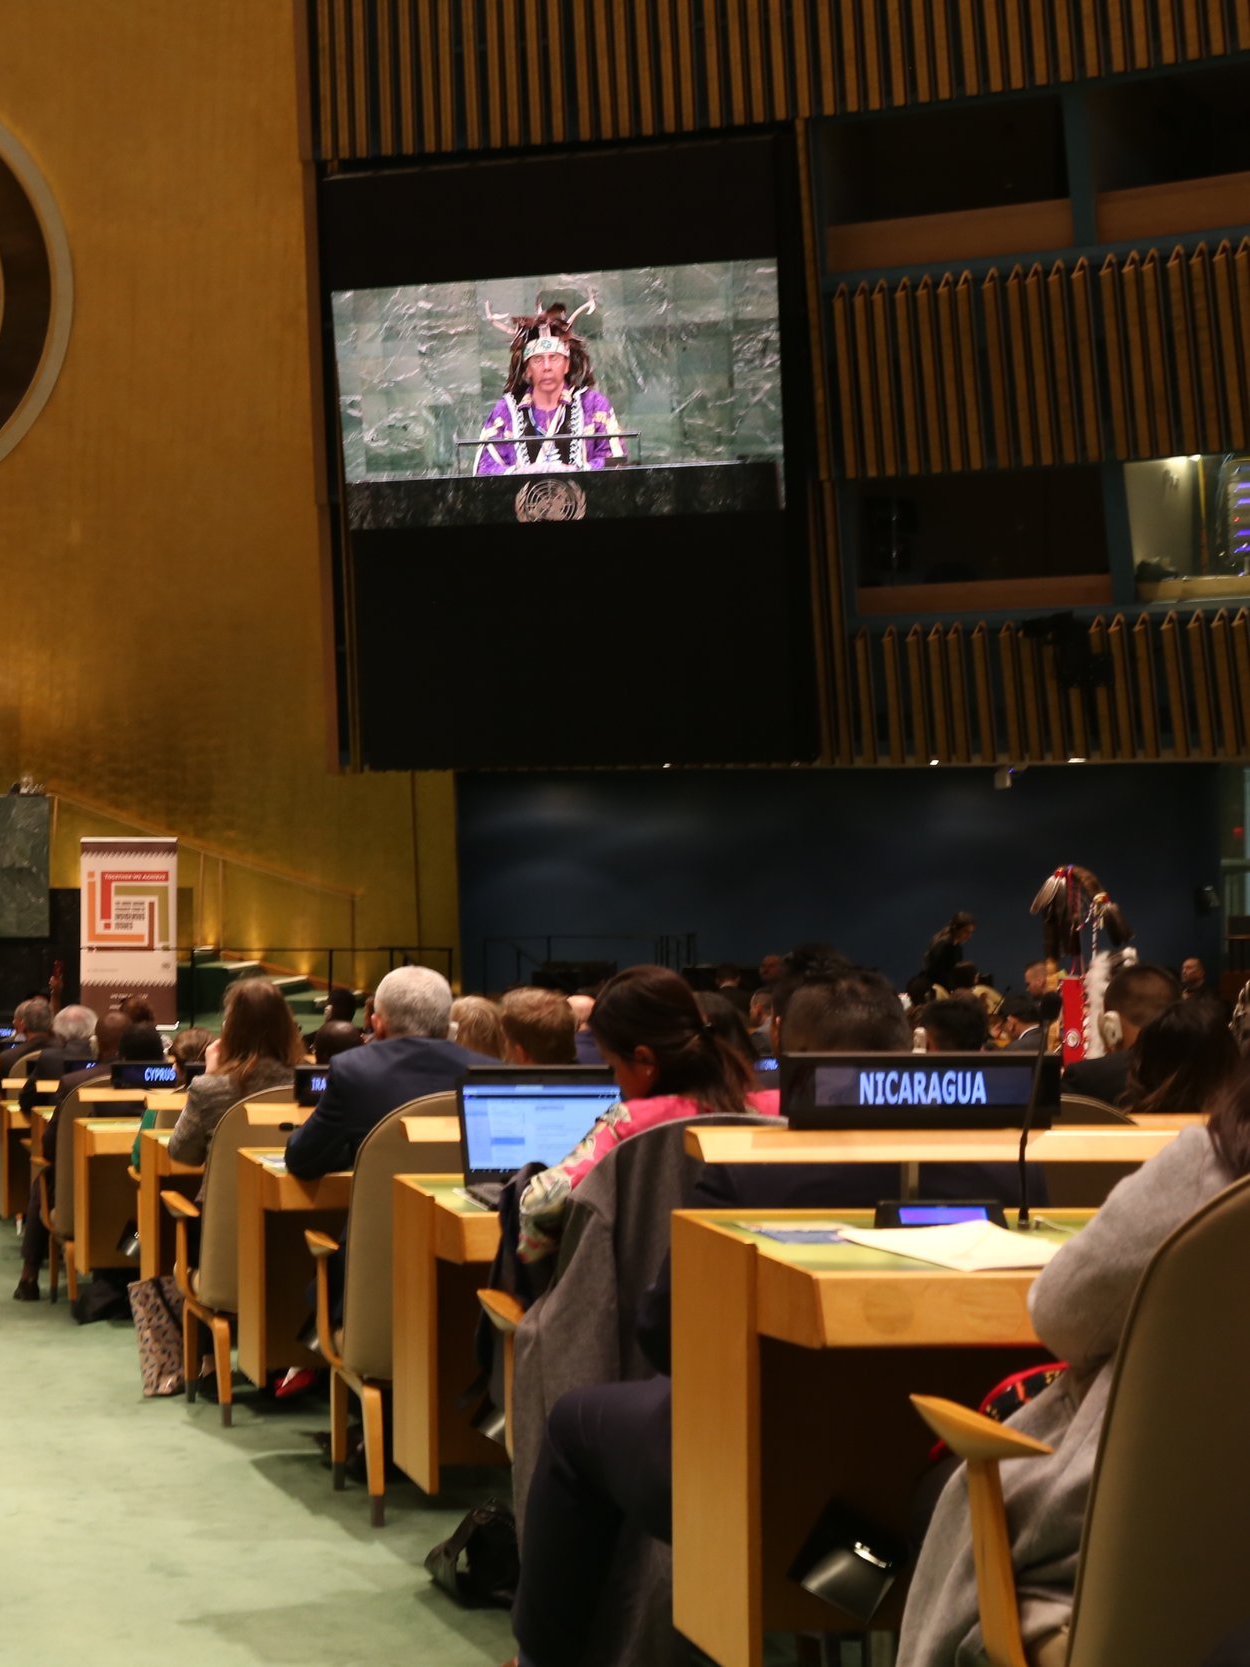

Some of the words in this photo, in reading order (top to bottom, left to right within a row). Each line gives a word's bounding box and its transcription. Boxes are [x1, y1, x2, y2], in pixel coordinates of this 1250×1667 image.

[144, 1067, 177, 1081] CYPRUS
[311, 1077, 327, 1091] IRA
[859, 1071, 987, 1104] NICARAGUA
